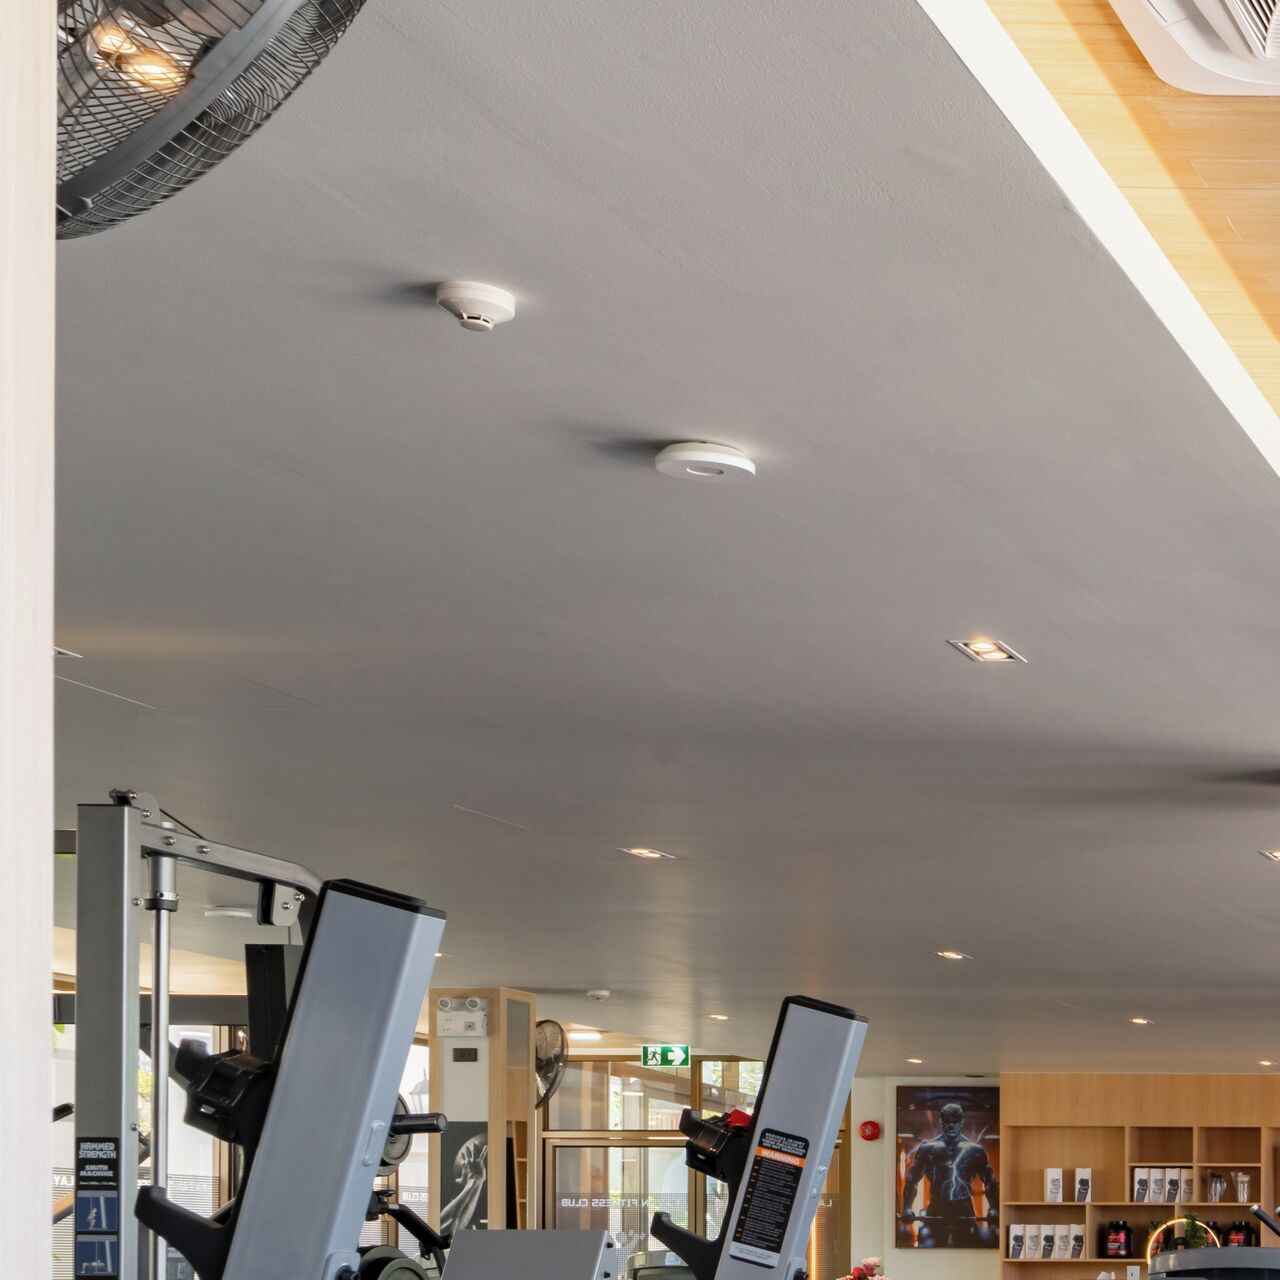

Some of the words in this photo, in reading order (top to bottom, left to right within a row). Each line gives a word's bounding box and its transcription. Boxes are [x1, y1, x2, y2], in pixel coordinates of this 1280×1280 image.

[80, 1142, 115, 1151] HAMMER
[79, 1150, 117, 1159] STRENGTH
[762, 1149, 801, 1165] WARNING
